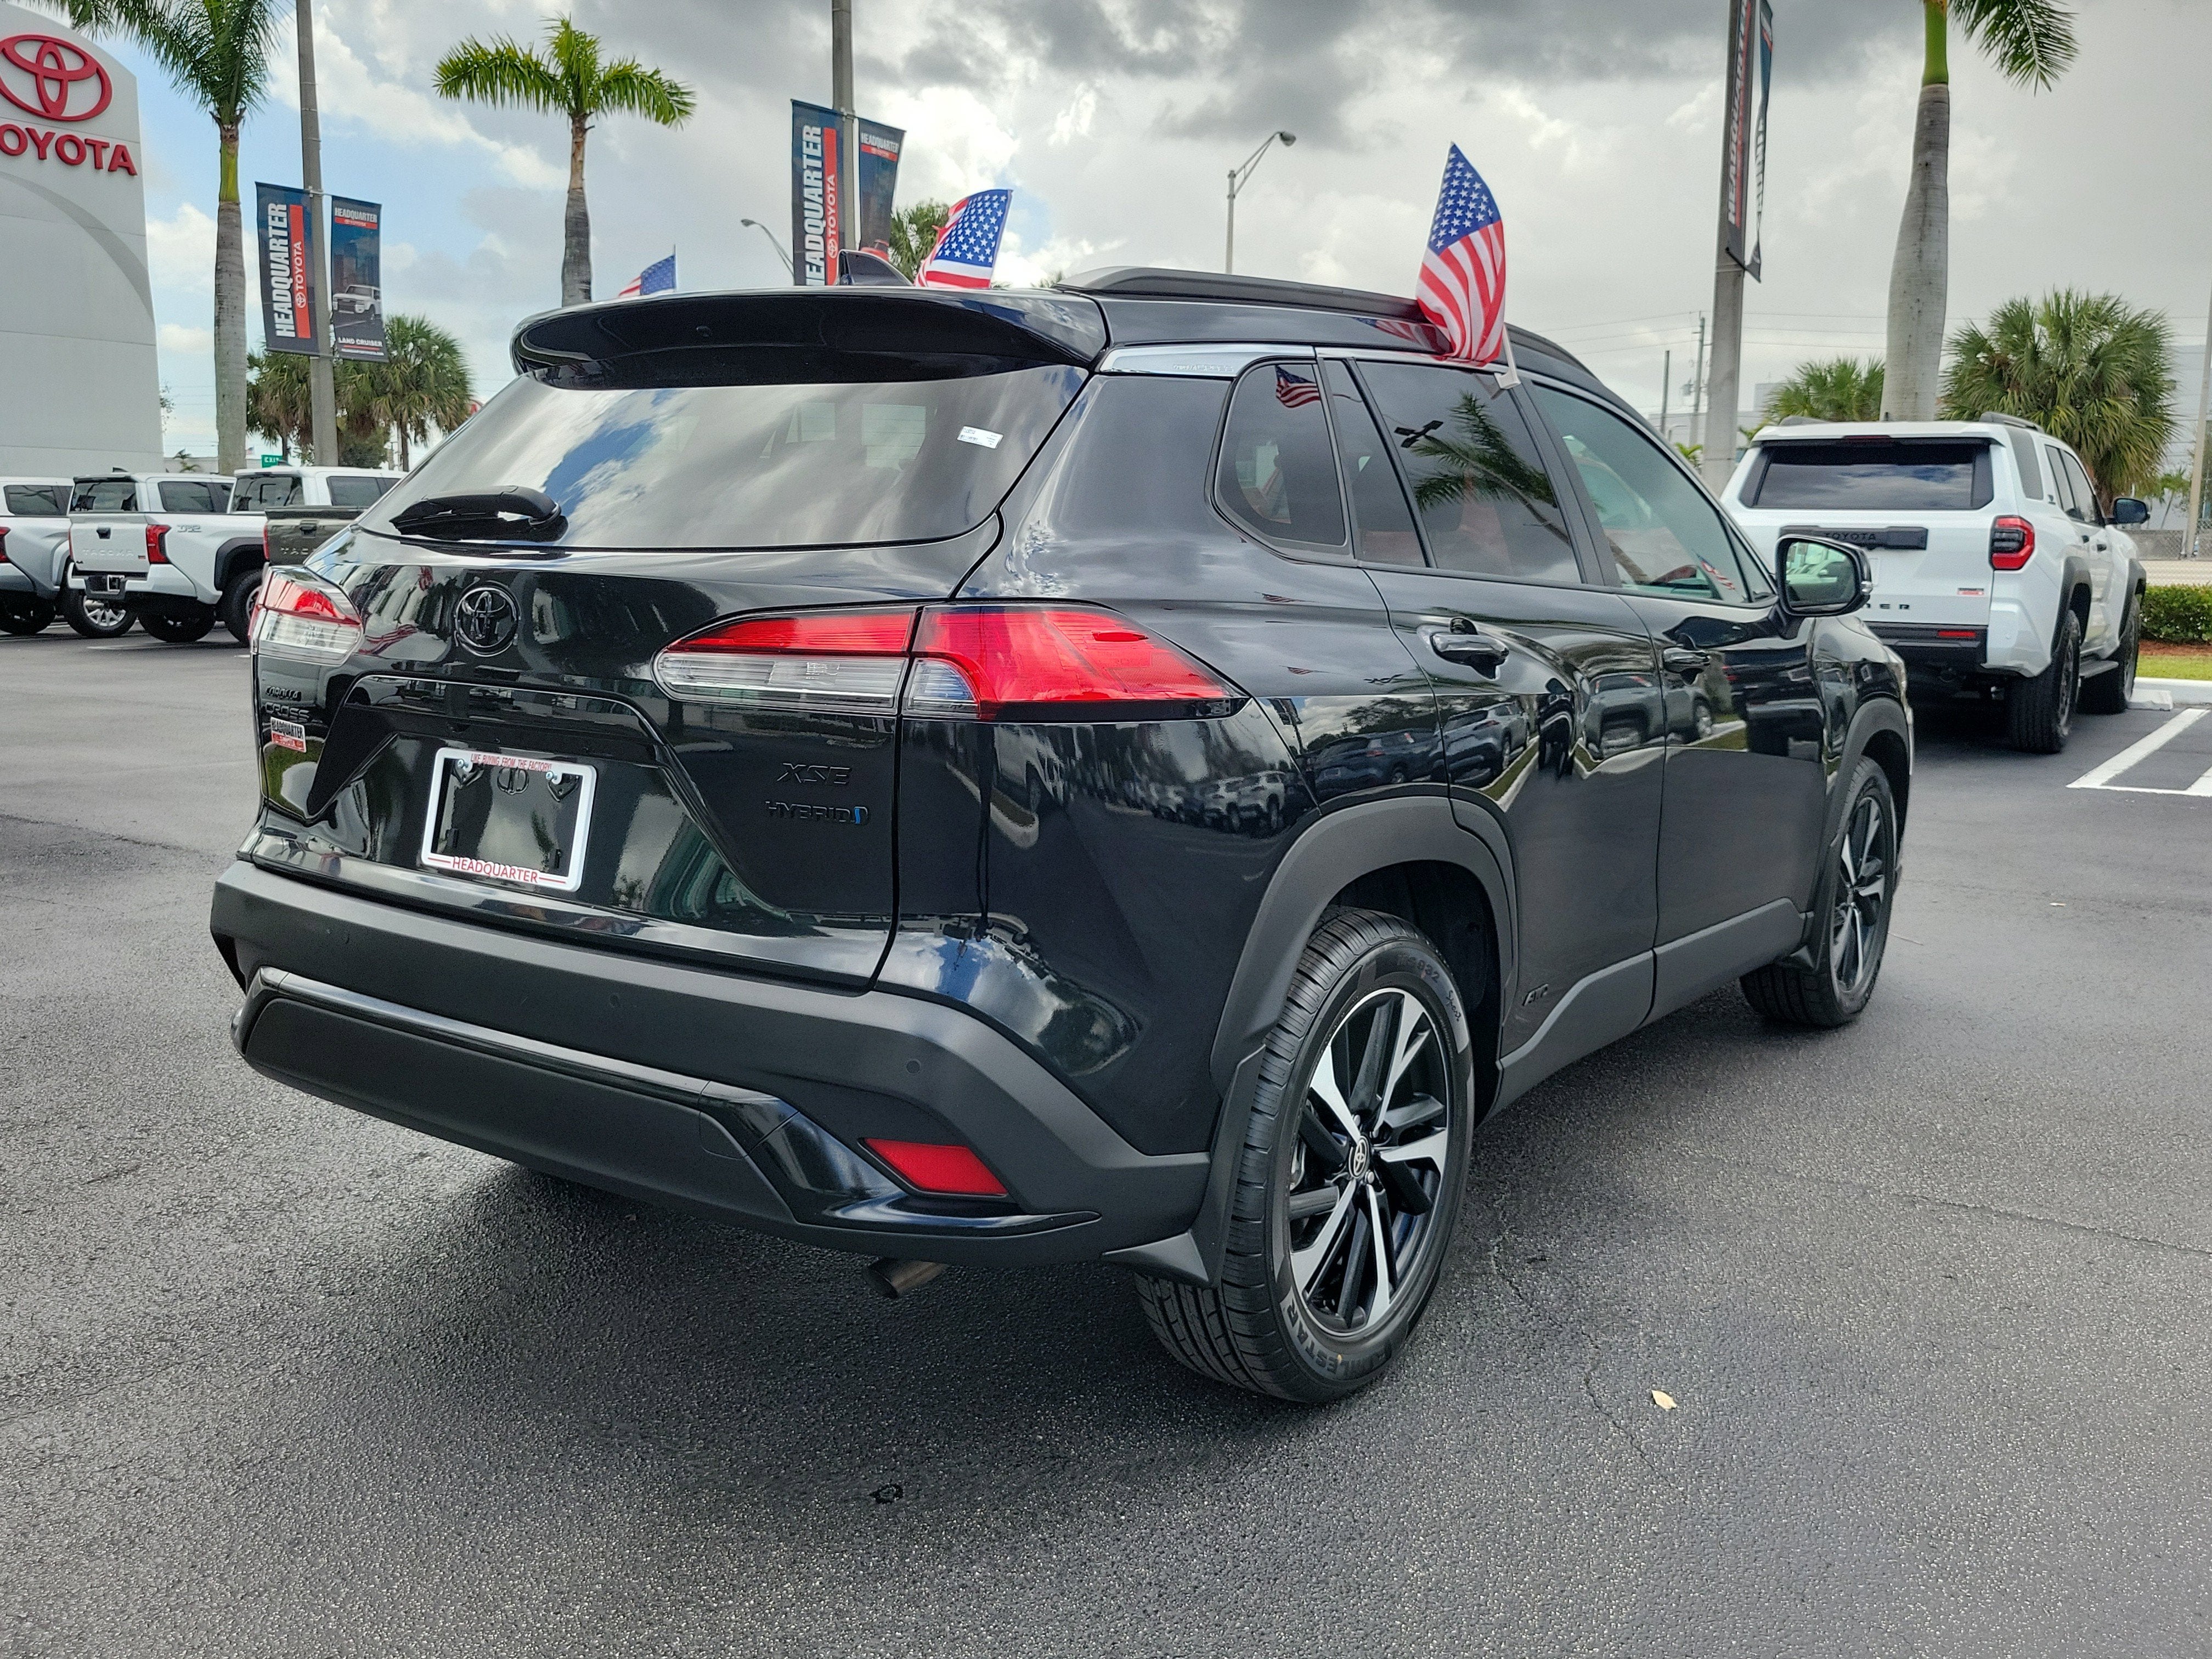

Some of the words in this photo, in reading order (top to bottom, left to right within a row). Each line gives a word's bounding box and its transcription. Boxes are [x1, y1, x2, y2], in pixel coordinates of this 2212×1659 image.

[334, 207, 377, 223] HEADQUARTER
[827, 174, 838, 237] TOYOTA
[267, 202, 296, 338] HEADQUARTER
[294, 241, 304, 291] TOYOTA
[356, 338, 383, 347] CRUISER
[1825, 532, 1876, 541] TOYOTA
[263, 702, 310, 721] CROSS
[471, 754, 481, 763] LIKE
[482, 755, 499, 766] BUYING
[501, 757, 516, 767] FROM
[518, 759, 527, 769] THE
[776, 762, 850, 785] XSE
[765, 801, 850, 823] HYBRID
[453, 856, 538, 883] HEADQUARTER
